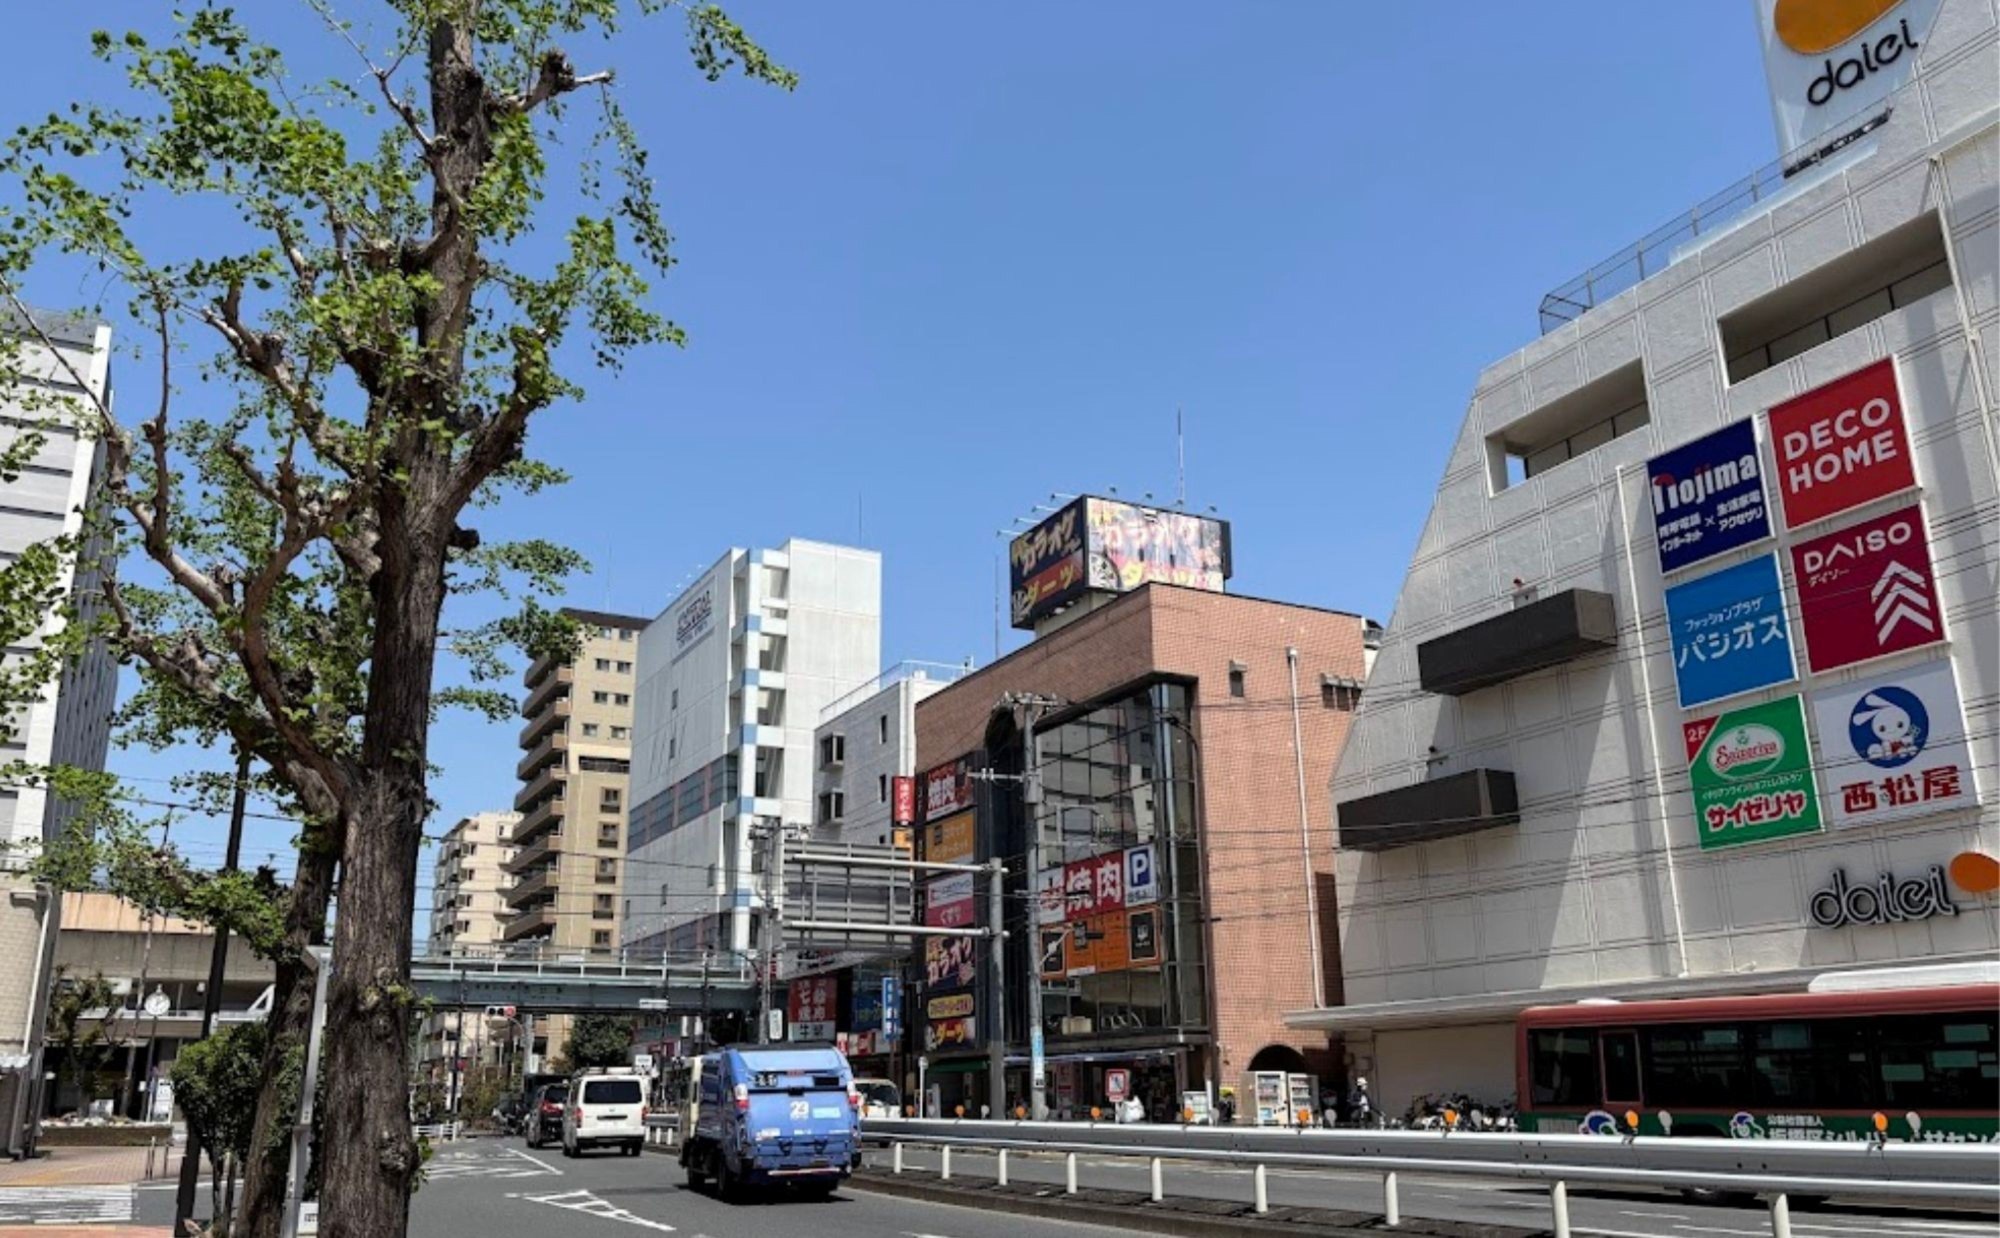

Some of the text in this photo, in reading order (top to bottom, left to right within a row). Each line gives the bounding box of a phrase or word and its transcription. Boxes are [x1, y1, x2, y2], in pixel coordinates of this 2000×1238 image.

[1807, 18, 1918, 106] daiei
[1783, 398, 1891, 461] DECO
[1789, 431, 1897, 493] HOME
[1804, 522, 1911, 574] DAISO
[1678, 614, 1784, 669] パシオス
[1688, 725, 1707, 743] 2F
[1706, 791, 1806, 831] サイゼリヤ
[1840, 765, 1961, 814] 西松屋
[1066, 860, 1121, 913] 焼肉
[1132, 853, 1148, 884] P
[1810, 864, 1961, 929] daiei
